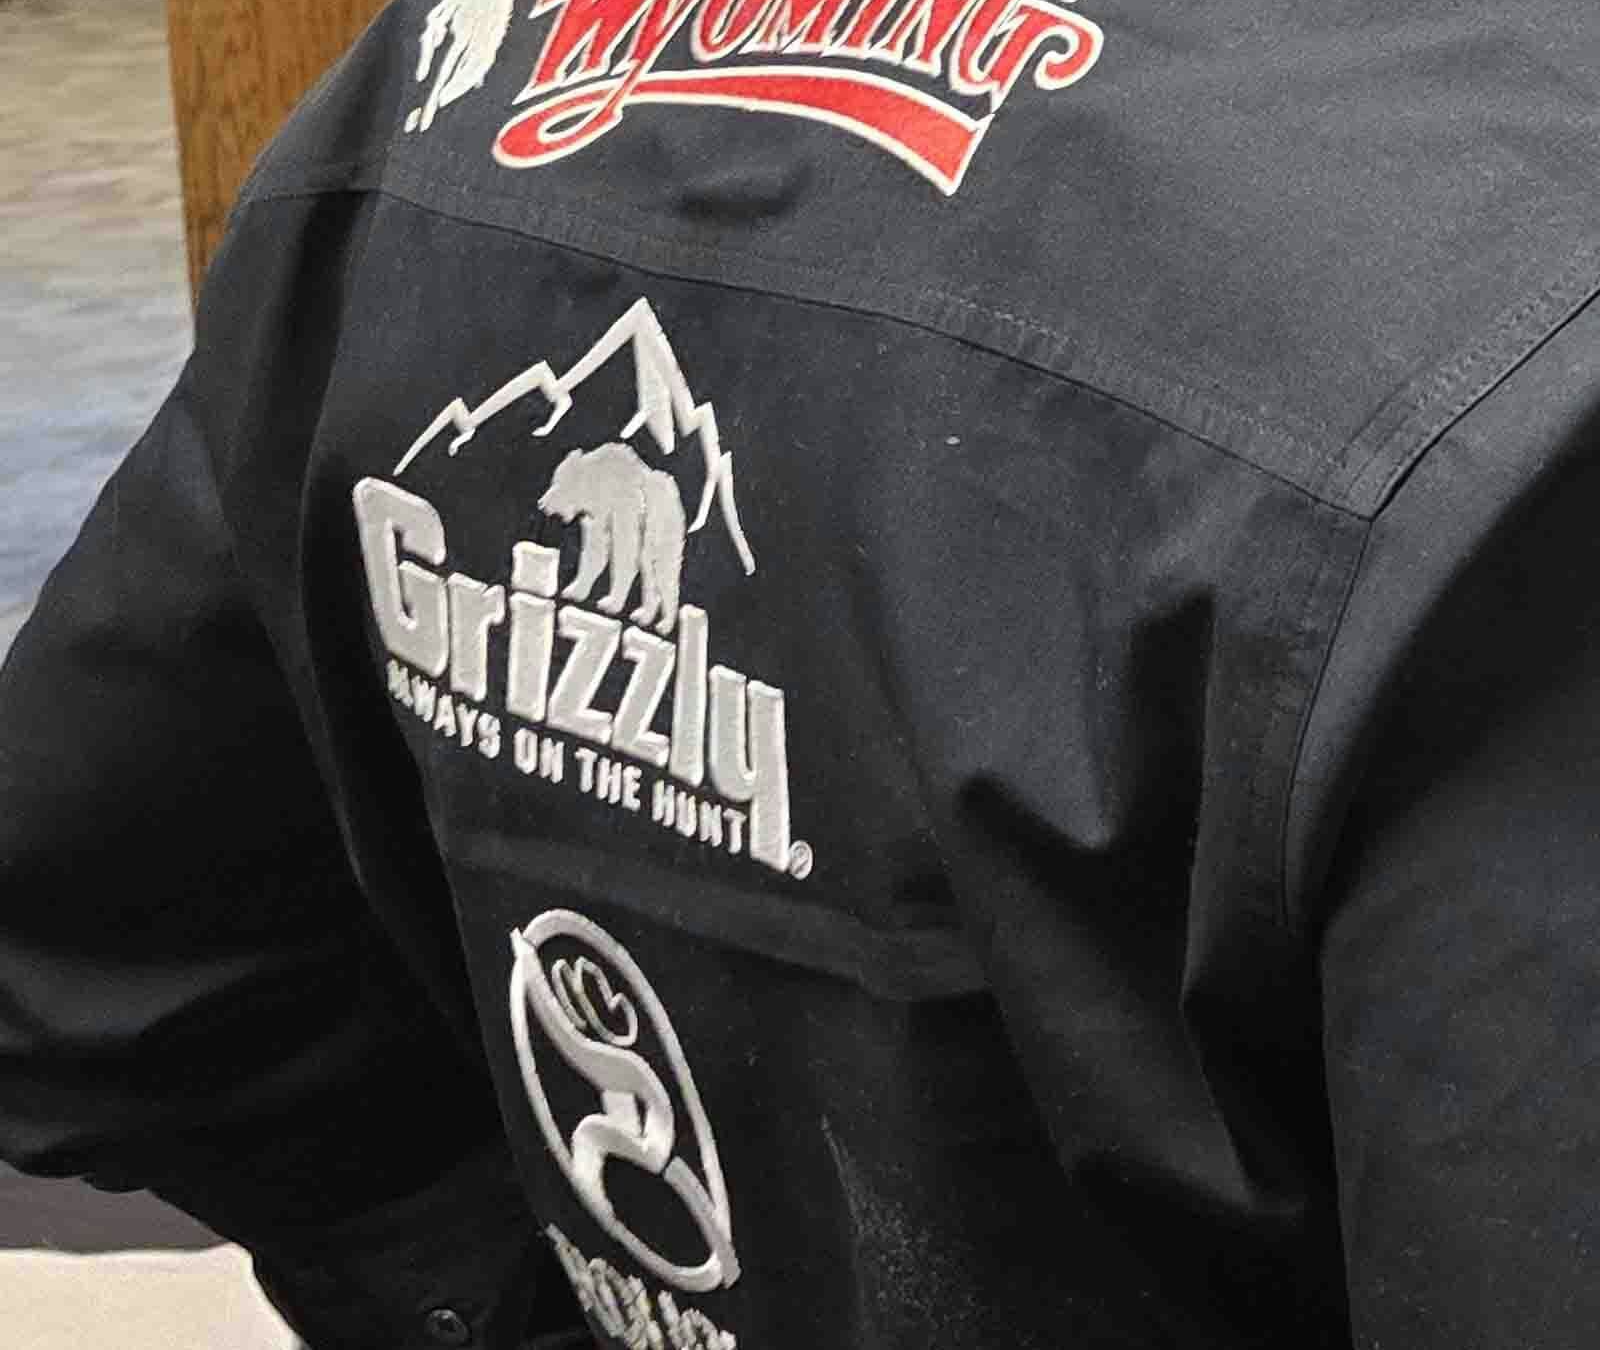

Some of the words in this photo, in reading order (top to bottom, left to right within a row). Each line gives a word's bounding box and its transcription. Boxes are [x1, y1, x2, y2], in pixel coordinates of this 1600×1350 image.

[353, 476, 792, 873] Grizzly
[514, 727, 565, 785] ON
[574, 746, 643, 812] THE
[652, 778, 748, 855] HUNT
